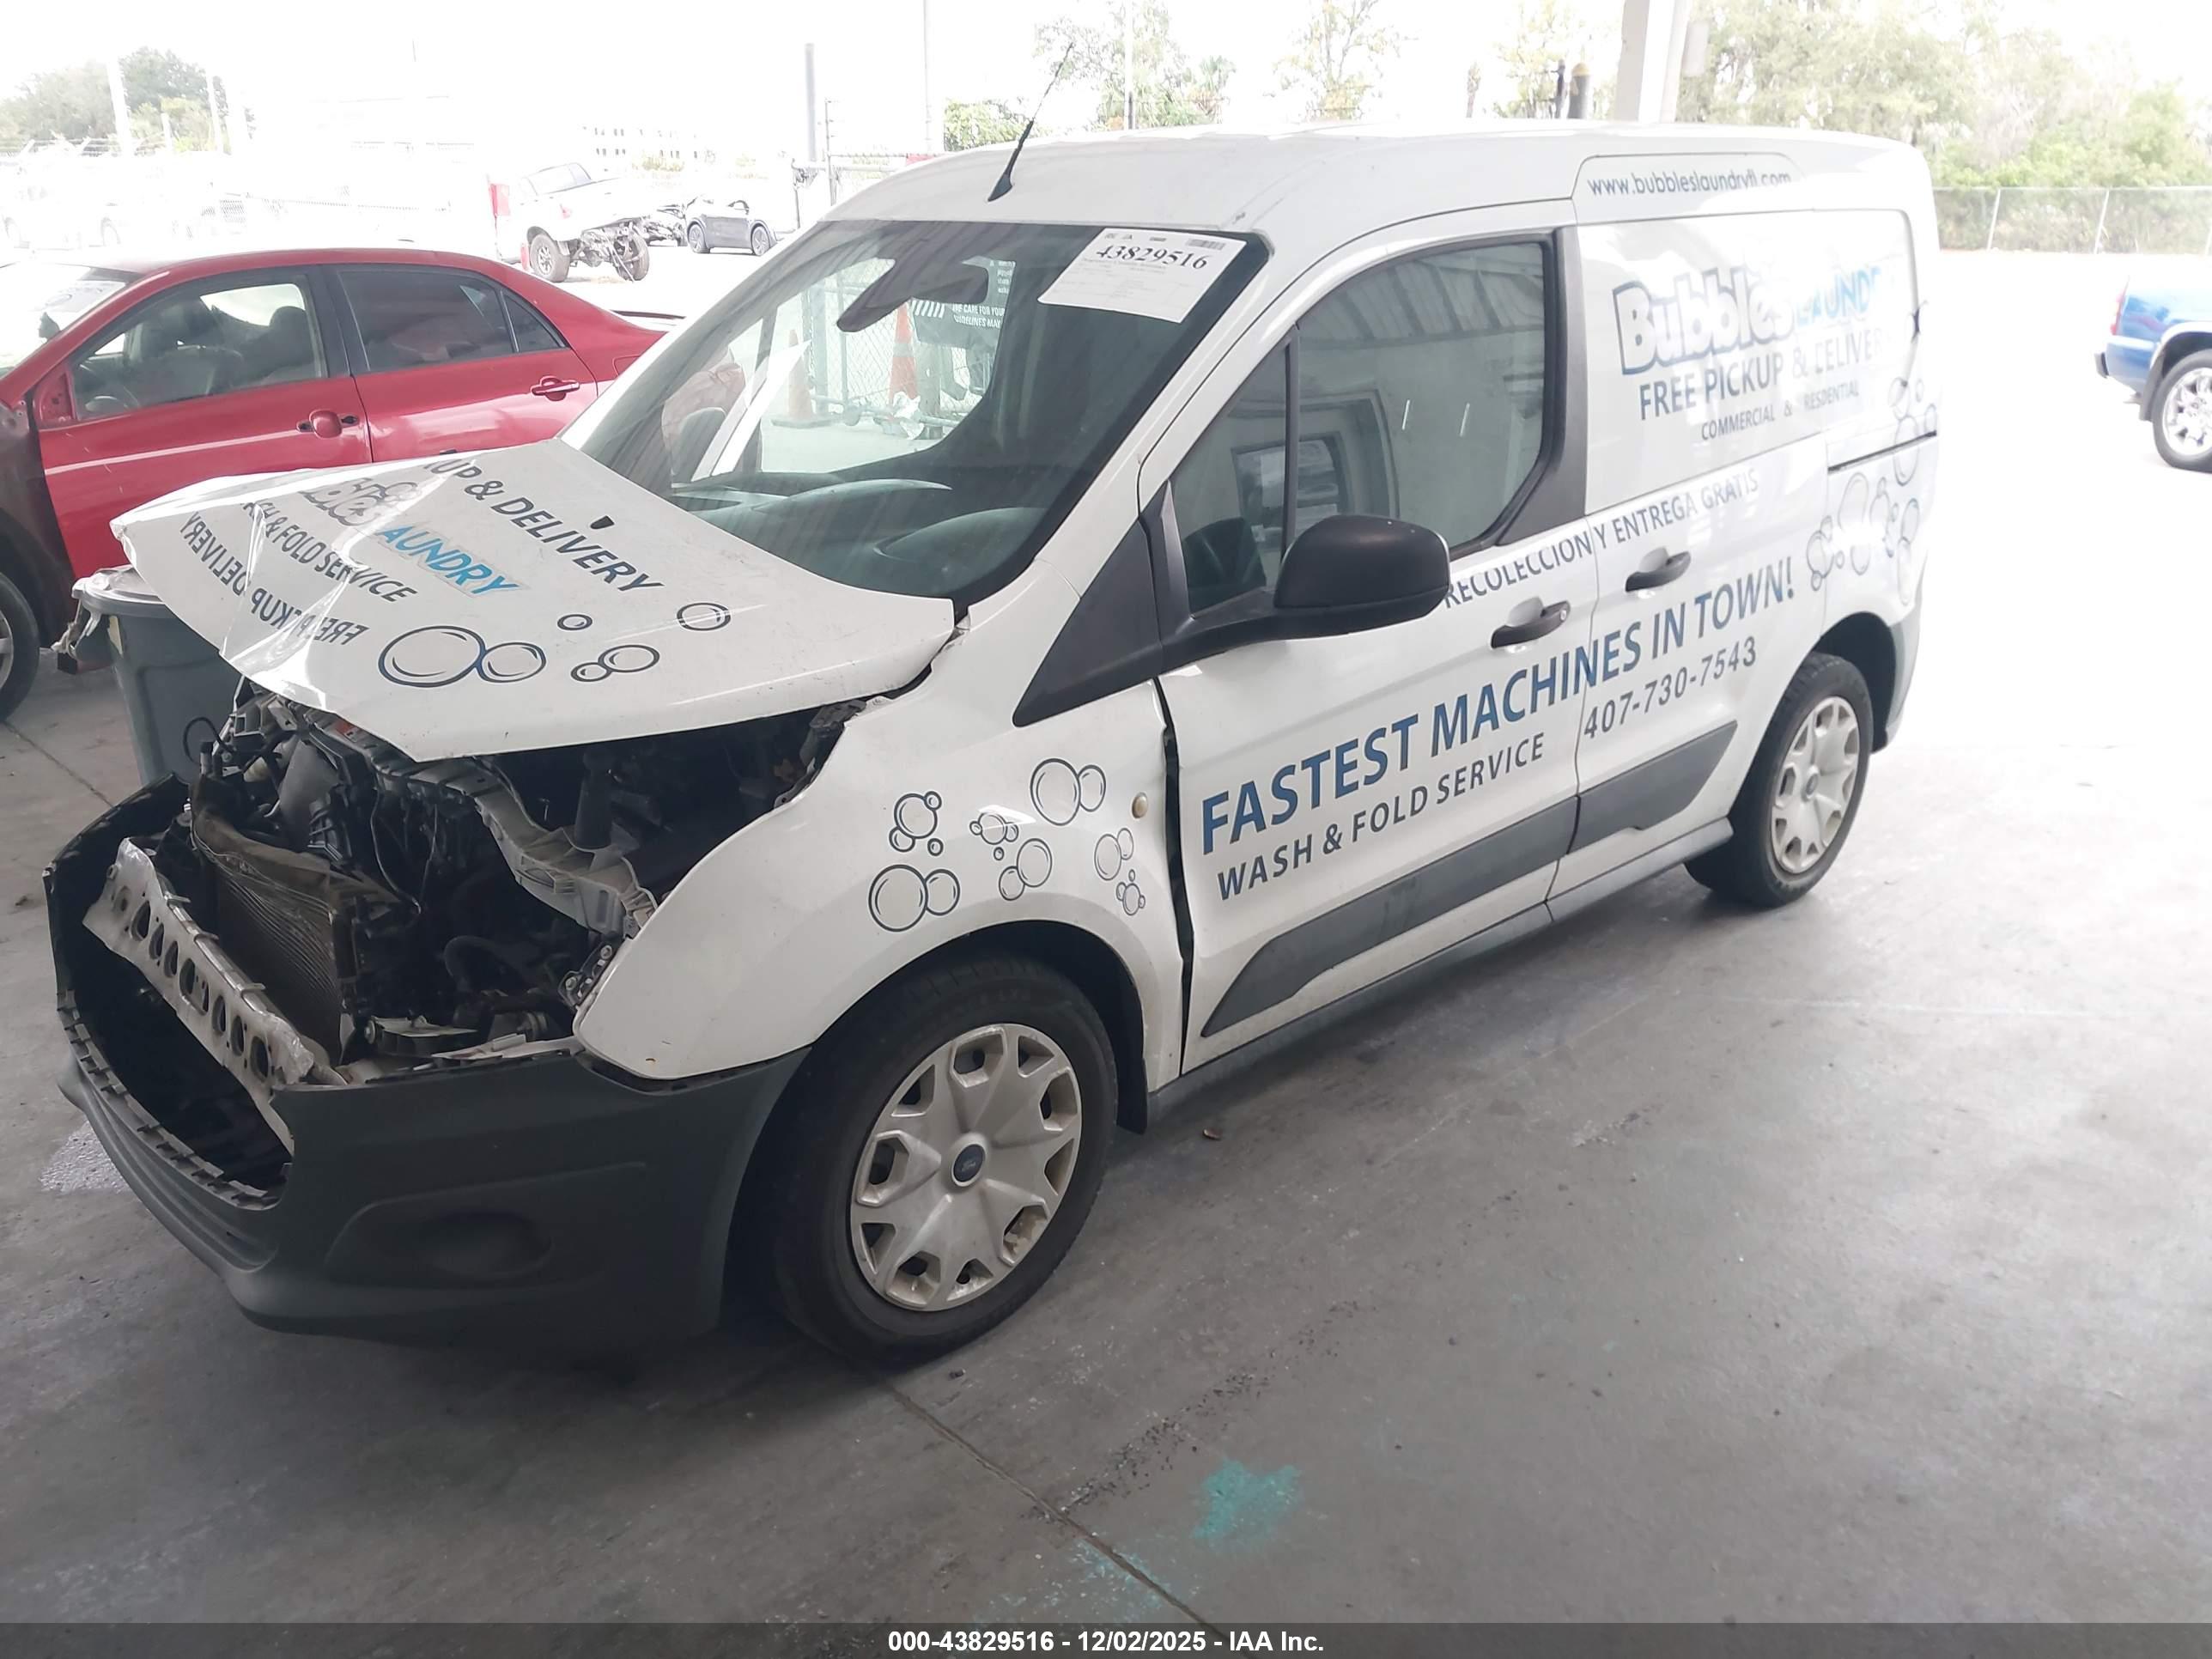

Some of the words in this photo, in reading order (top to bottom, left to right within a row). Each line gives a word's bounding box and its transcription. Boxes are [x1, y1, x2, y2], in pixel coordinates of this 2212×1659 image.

[1096, 245, 1211, 270] 43829516
[1613, 266, 1795, 376] Bubbles
[1639, 373, 1697, 421] FREE
[1704, 351, 1784, 404] PICKUP
[1792, 345, 1809, 379] &
[1701, 405, 1776, 441] COMMERCIAL
[1784, 399, 1794, 417] &
[272, 525, 327, 563] FOLD
[314, 551, 418, 602] SERVICE
[374, 526, 520, 594] AUNDRY
[464, 480, 505, 501] &
[490, 497, 665, 592] DELIVERY
[1444, 530, 1594, 610] RECOLECCION
[1593, 526, 1608, 550] Y
[1612, 492, 1698, 544] ENTREGA
[1700, 467, 1759, 510] GRATIS
[1202, 714, 1419, 855] FASTEST
[1431, 621, 1641, 757] MACHINES
[1651, 603, 1686, 659] IN
[1694, 556, 1795, 638] TOWN!
[1583, 635, 1757, 739] 407-730-7543
[1218, 834, 1313, 902] WASH
[1322, 823, 1343, 855] &
[1352, 785, 1429, 843] FOLD
[1436, 732, 1544, 804] SERVICE
